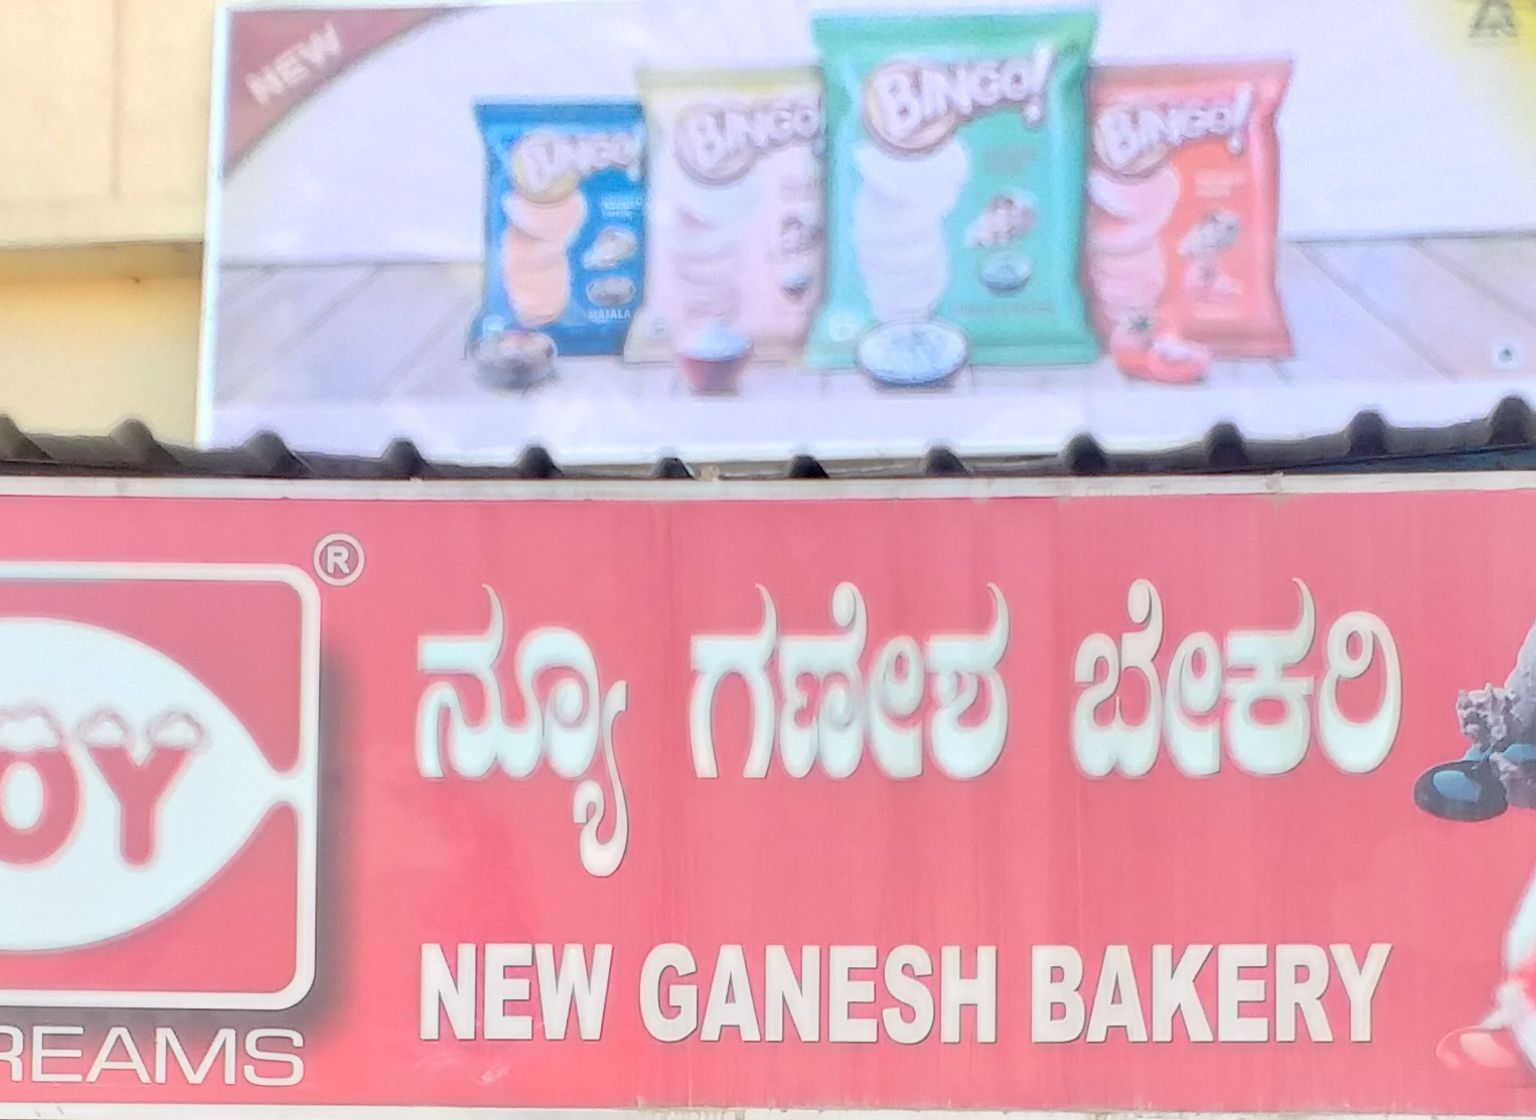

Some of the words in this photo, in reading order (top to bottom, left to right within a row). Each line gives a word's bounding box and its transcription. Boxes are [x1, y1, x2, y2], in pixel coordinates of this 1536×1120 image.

[244, 20, 342, 106] NEW
[686, 98, 824, 174] BINGO
[415, 583, 629, 877] ನ್ಯೂ
[690, 580, 1010, 781] ಗಣೇಶ
[1070, 577, 1404, 777] ಬೇಕರಿ
[419, 942, 613, 1041] NEW
[639, 942, 998, 1044] GANESH
[1031, 942, 1393, 1044] BAKERY
